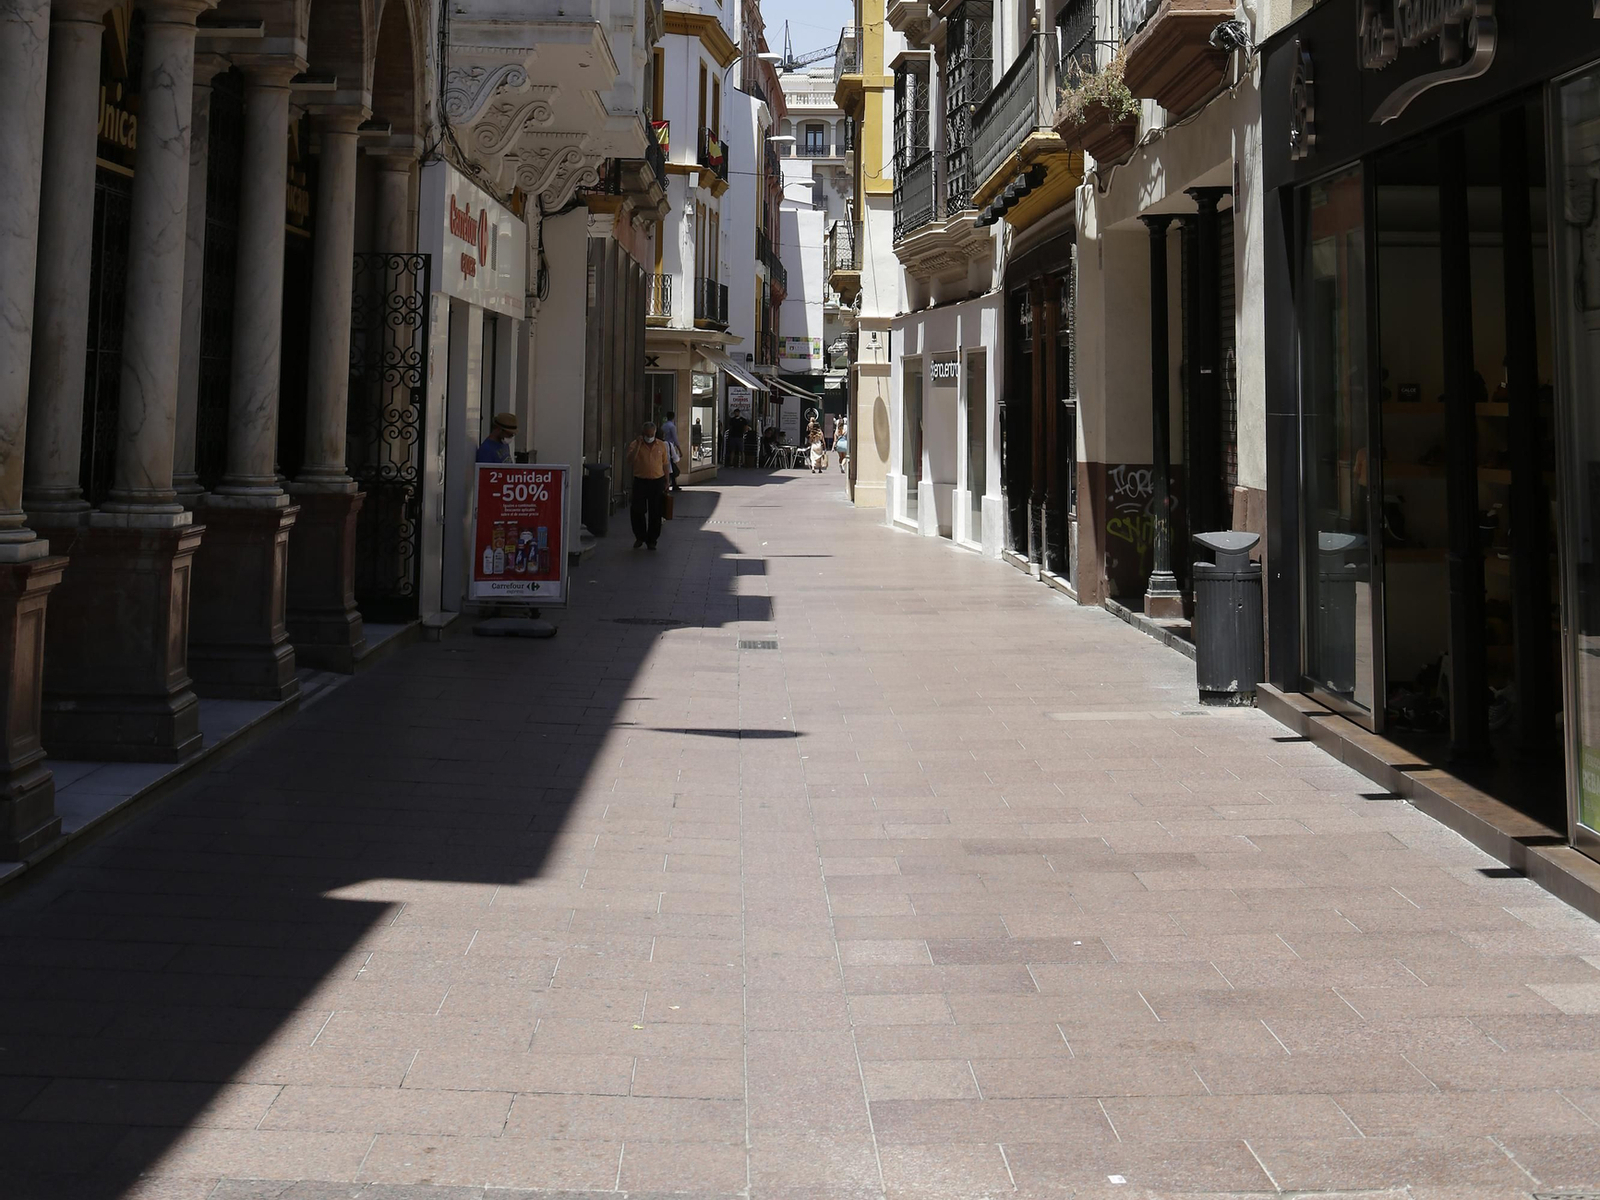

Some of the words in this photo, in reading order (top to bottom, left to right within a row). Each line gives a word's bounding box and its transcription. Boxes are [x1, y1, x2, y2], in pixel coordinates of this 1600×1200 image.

[506, 471, 552, 483] unidad
[492, 484, 549, 501] -50%
[491, 582, 525, 590] Carrefour
